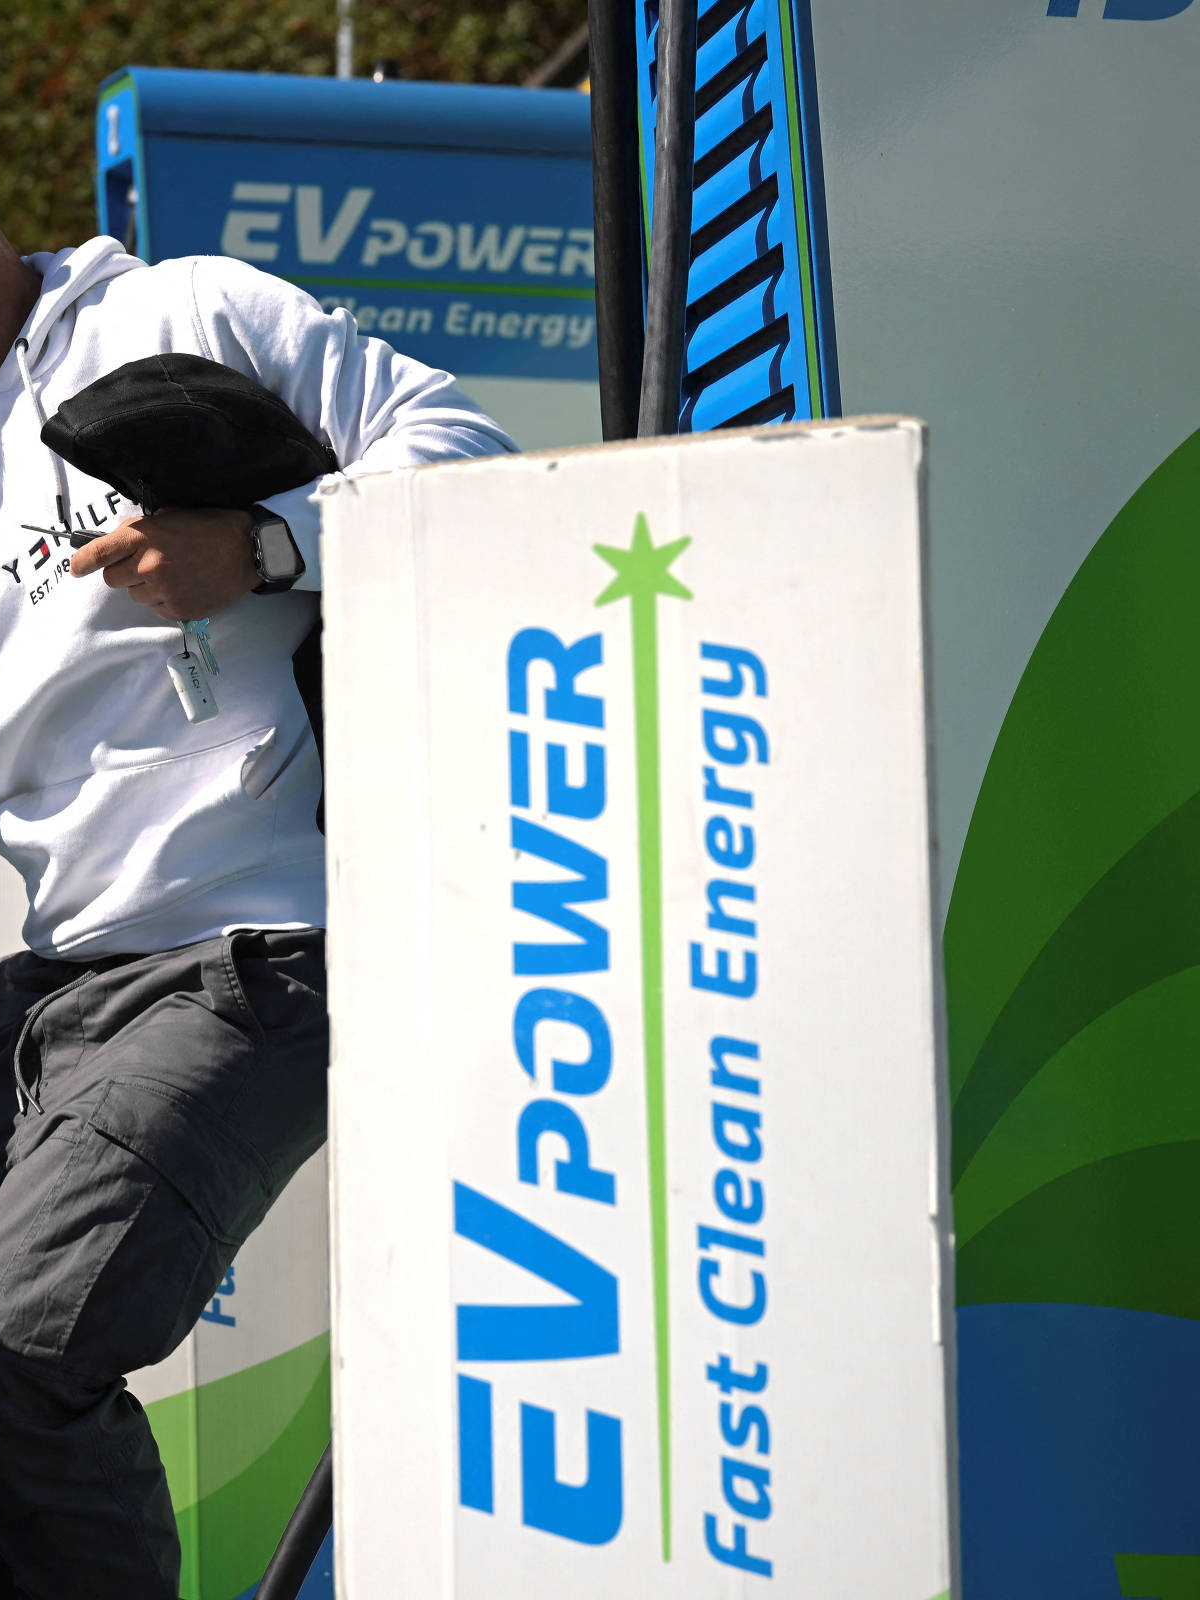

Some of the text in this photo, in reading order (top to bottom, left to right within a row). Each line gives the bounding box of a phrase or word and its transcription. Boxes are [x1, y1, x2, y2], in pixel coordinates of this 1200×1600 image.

[444, 303, 595, 349] Energy
[29, 554, 75, 606] EST. 198
[689, 641, 773, 1579] Fast Clean Energy
